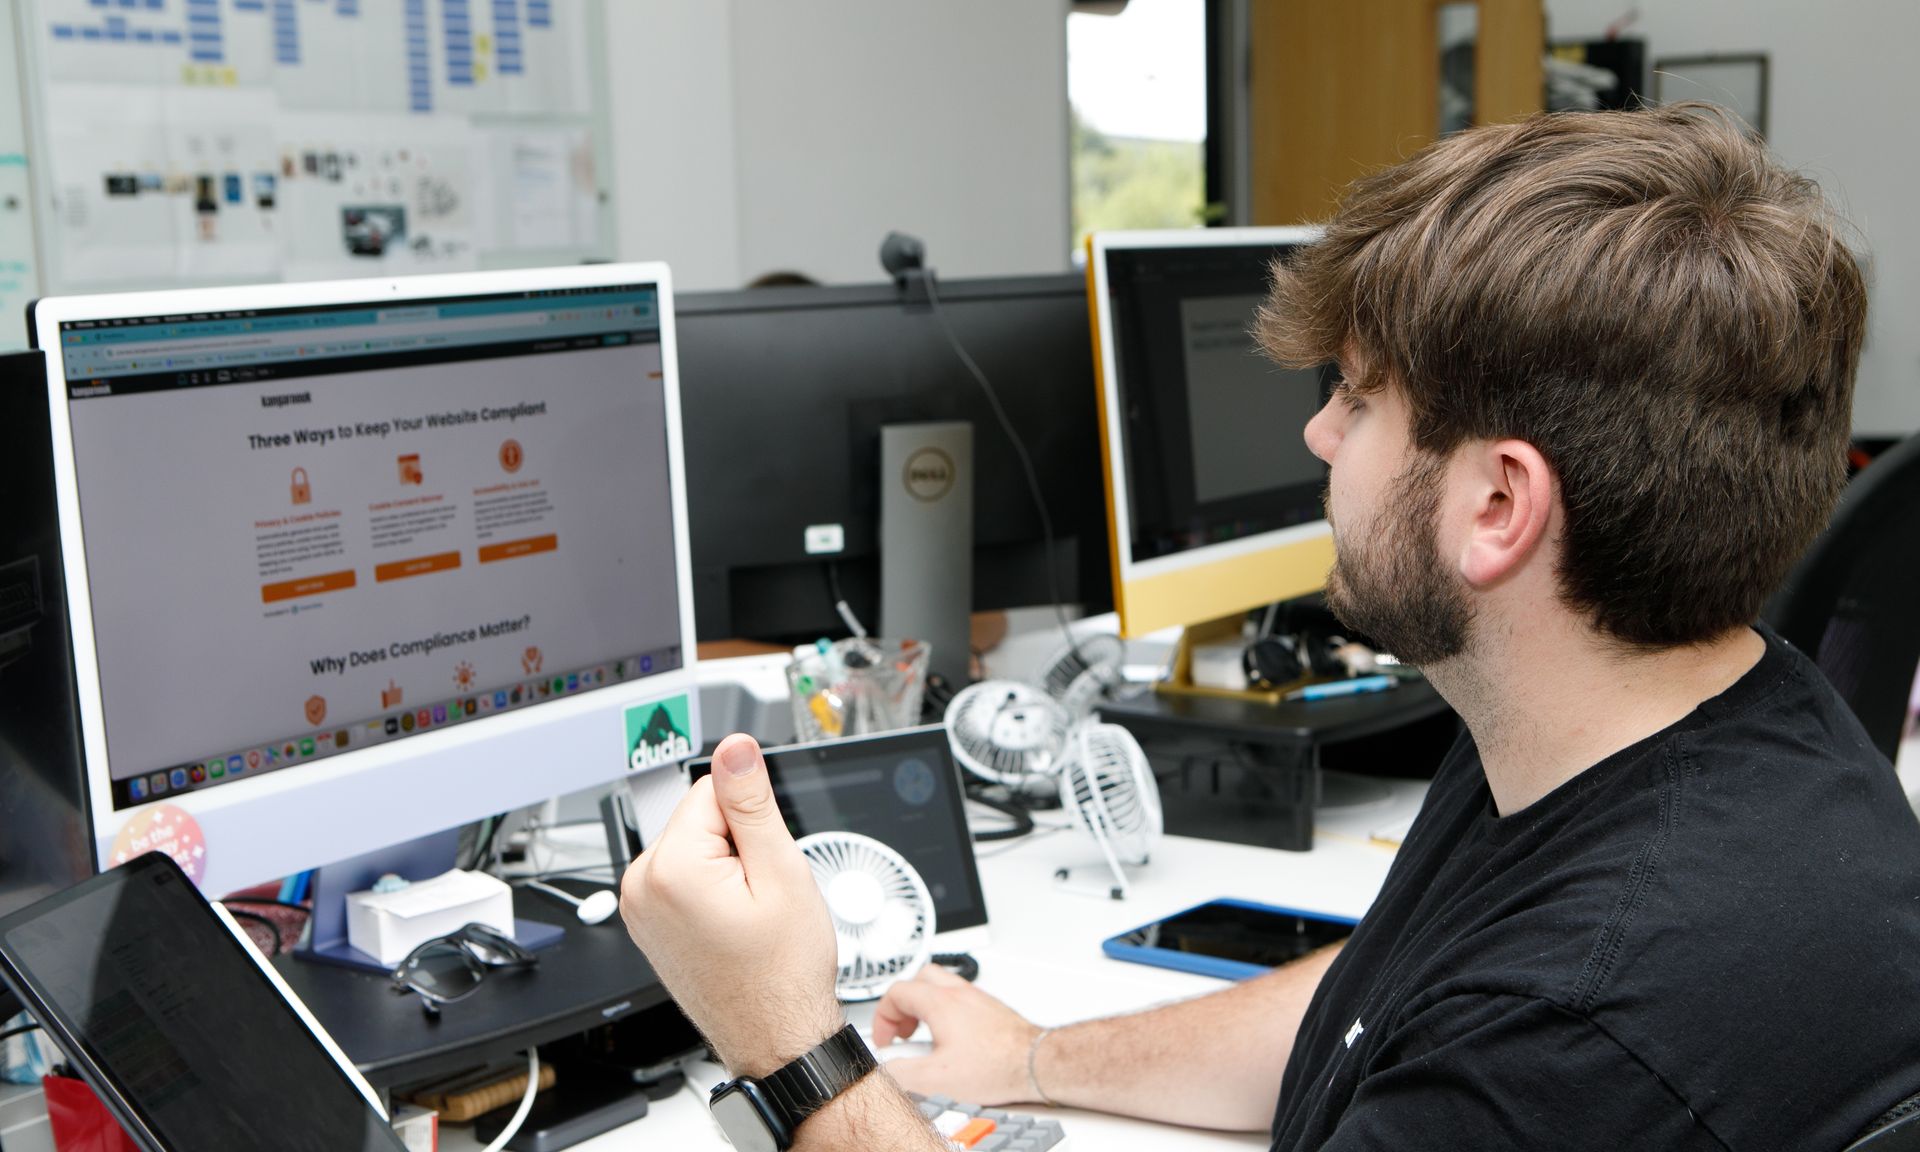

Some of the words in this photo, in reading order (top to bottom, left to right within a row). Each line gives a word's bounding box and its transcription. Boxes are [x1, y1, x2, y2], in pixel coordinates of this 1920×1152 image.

[248, 433, 291, 449] Three
[294, 428, 335, 446] Ways
[338, 425, 353, 438] to
[355, 421, 391, 439] Keep
[393, 417, 422, 431] Your
[426, 409, 478, 428] Website
[481, 401, 547, 422] Compliant
[310, 656, 346, 675] Why
[350, 648, 387, 668] Does
[389, 628, 477, 655] Compliance
[479, 614, 531, 639] Matter?
[631, 730, 690, 769] duda
